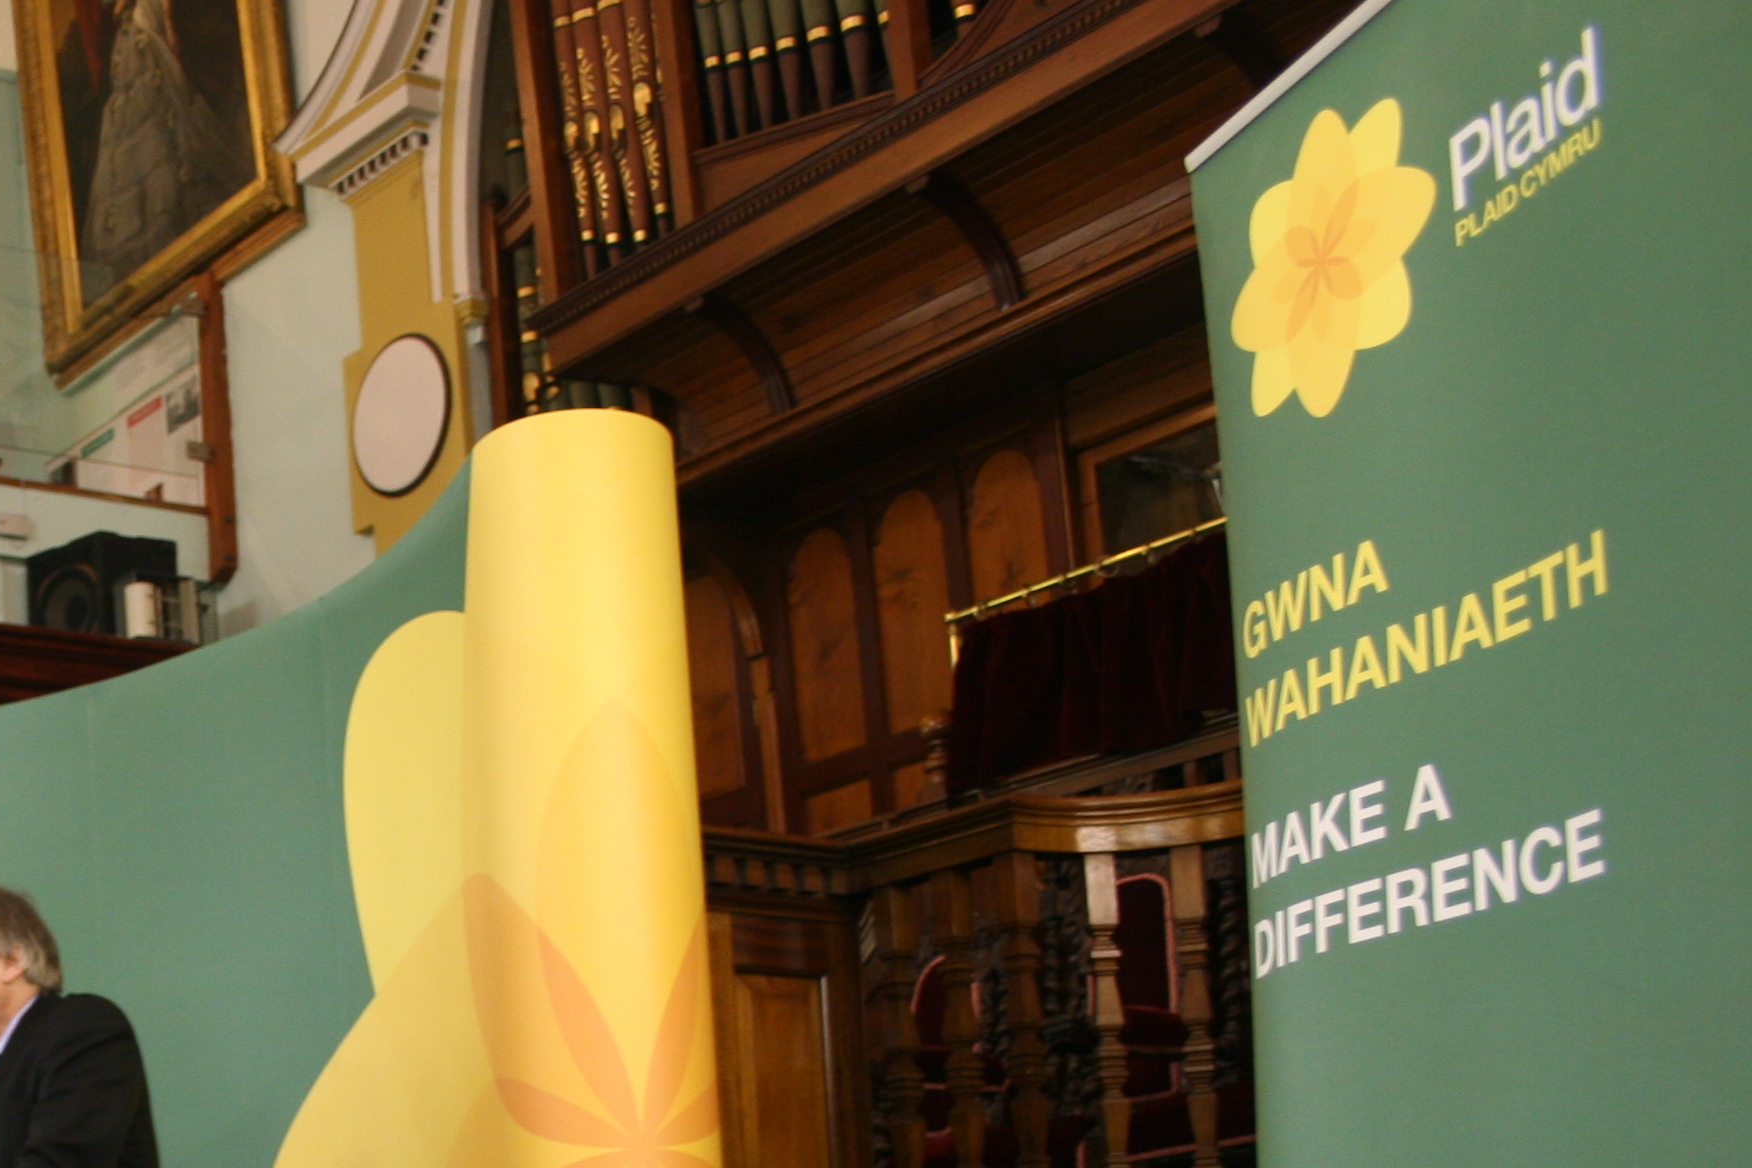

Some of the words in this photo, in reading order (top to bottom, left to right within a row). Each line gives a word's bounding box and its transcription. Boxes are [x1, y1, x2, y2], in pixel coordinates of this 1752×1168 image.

[1449, 25, 1601, 212] Plaid
[1454, 183, 1520, 248] PLAID
[1518, 116, 1602, 198] CYMRU
[1243, 539, 1391, 660] GWNA
[1245, 528, 1610, 748] WAHANIAETH
[1251, 780, 1389, 890] MAKE
[1404, 763, 1453, 833] A
[1254, 808, 1607, 980] DIFFERENCE
